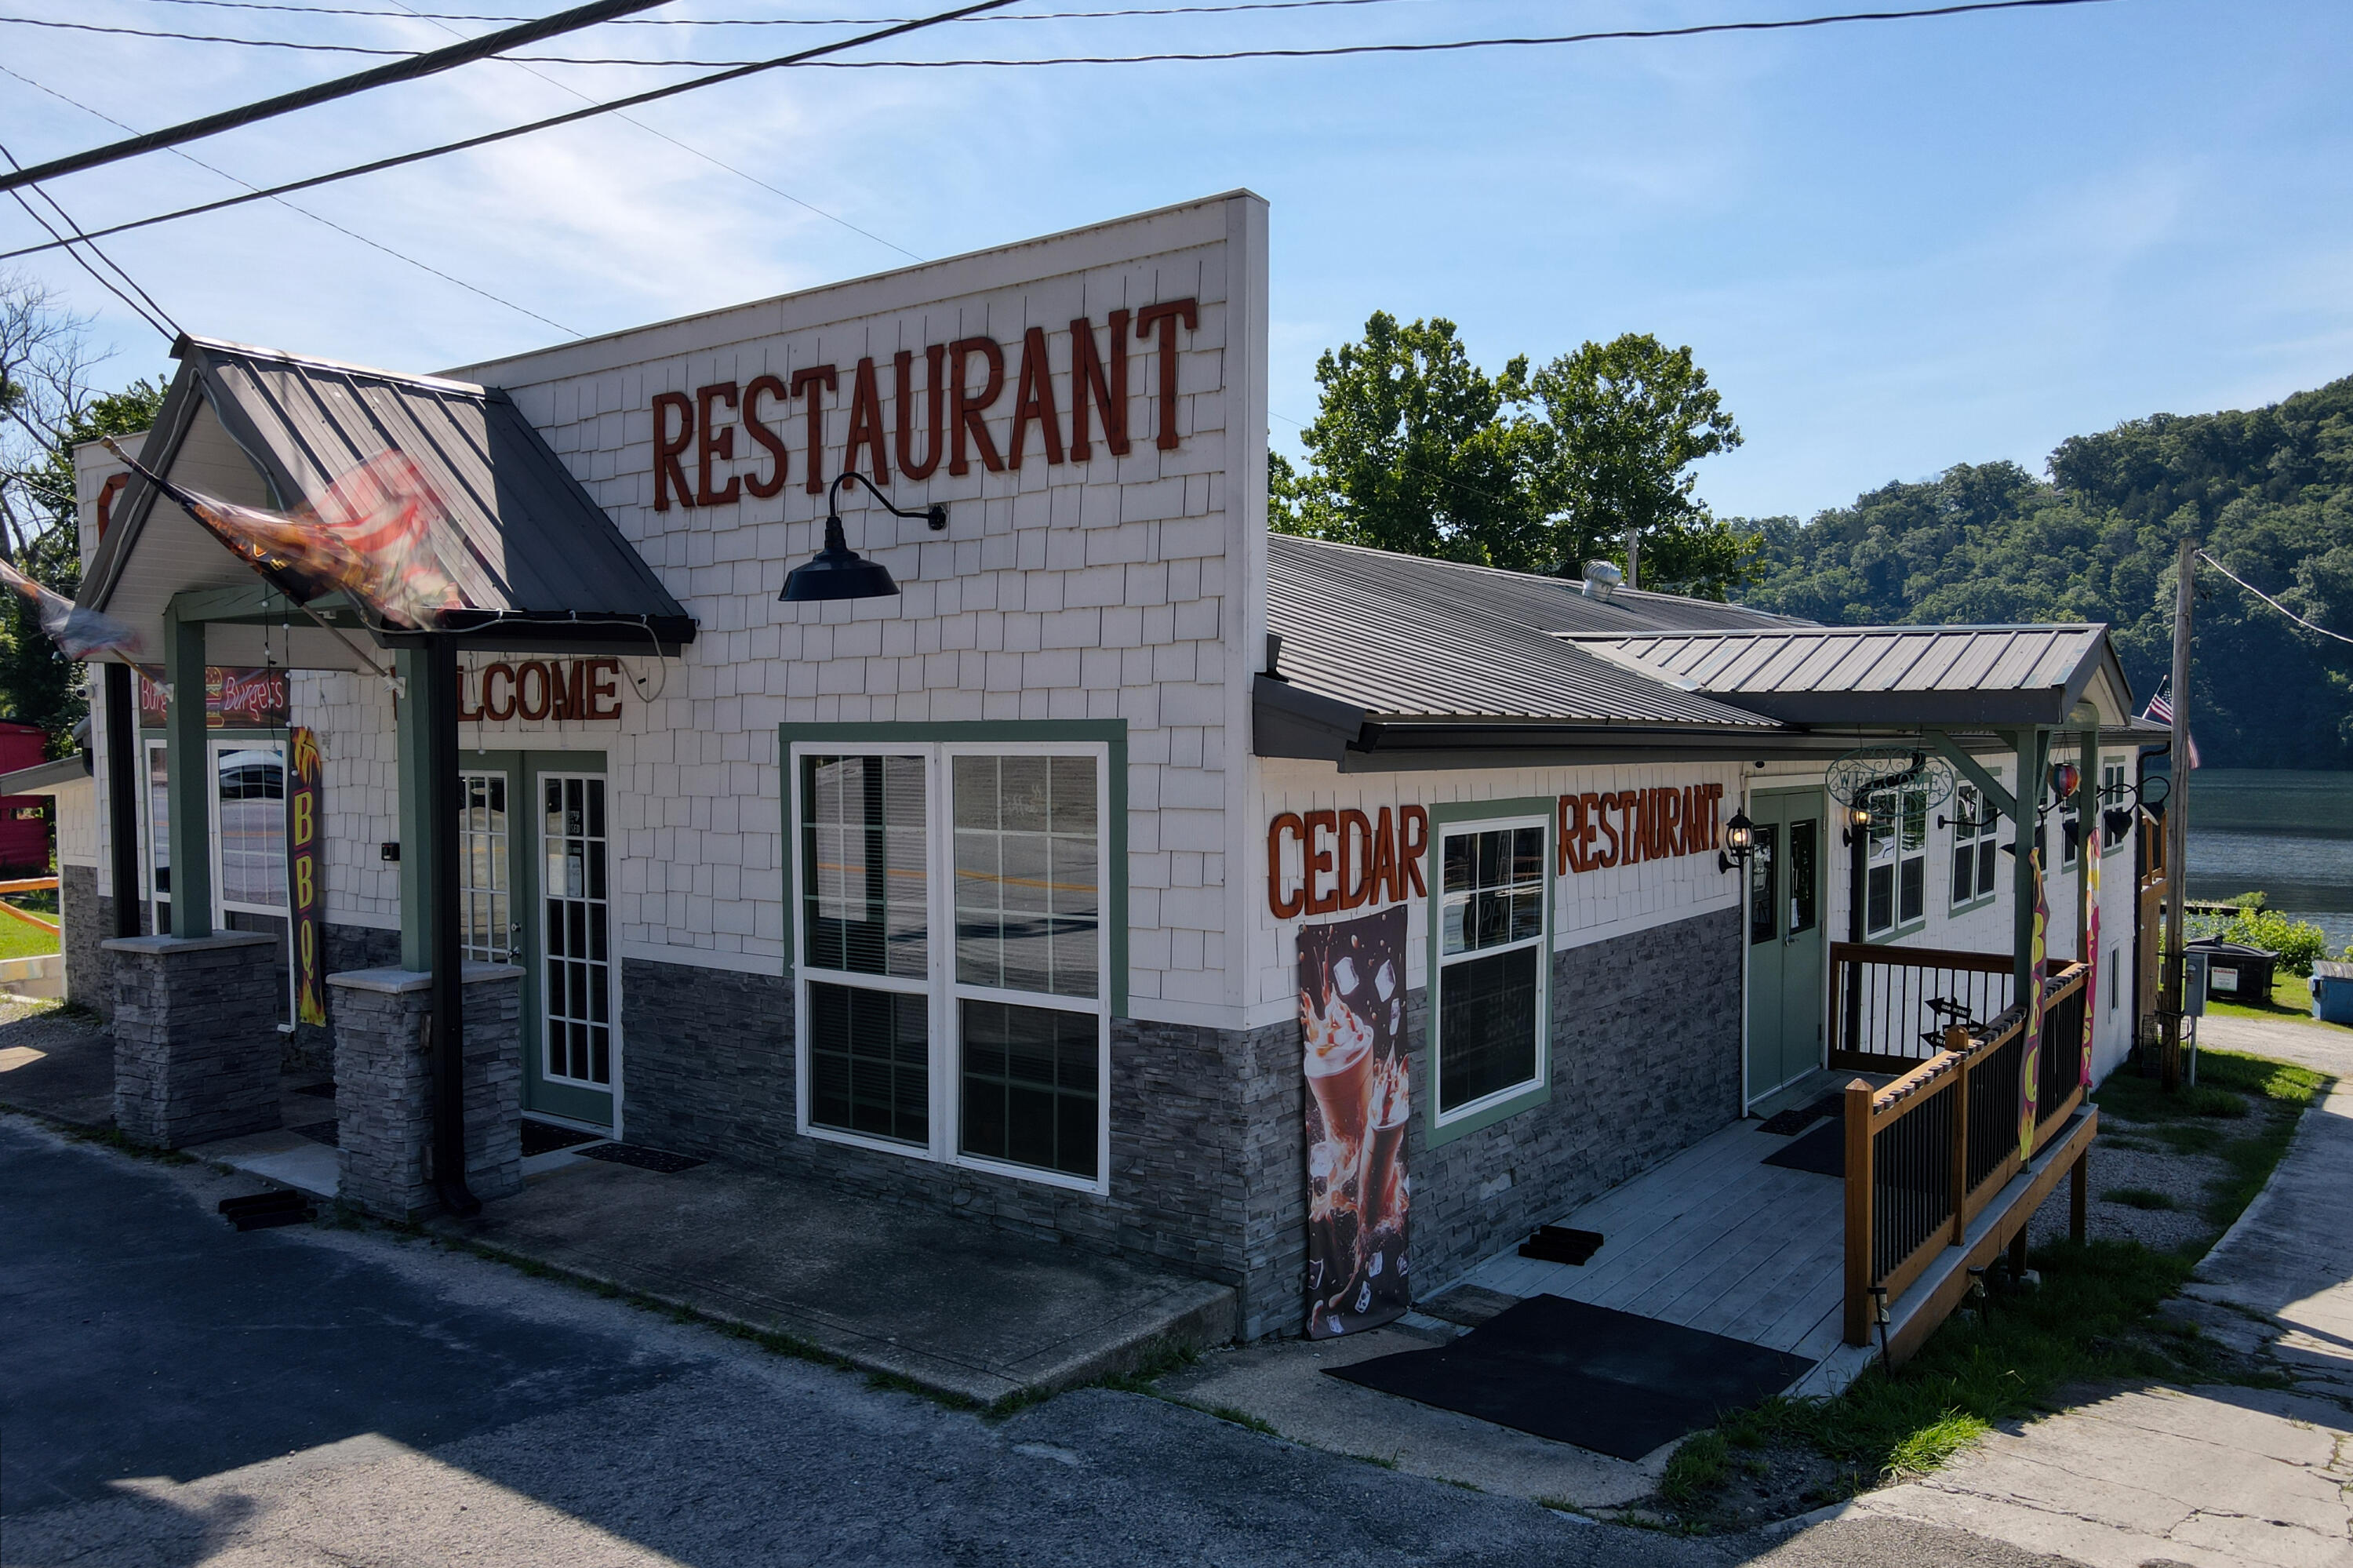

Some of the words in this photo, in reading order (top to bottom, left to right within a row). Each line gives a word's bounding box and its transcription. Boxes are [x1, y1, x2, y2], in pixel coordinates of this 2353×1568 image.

[653, 298, 1198, 511] RESTAURANT
[224, 676, 283, 721] Burgers
[390, 657, 622, 722] LCOME
[1839, 771, 1940, 792] WELCOME
[294, 790, 314, 980] BBQ
[1268, 804, 1427, 919] CEDAR
[1558, 783, 1723, 876] RESTAURANT
